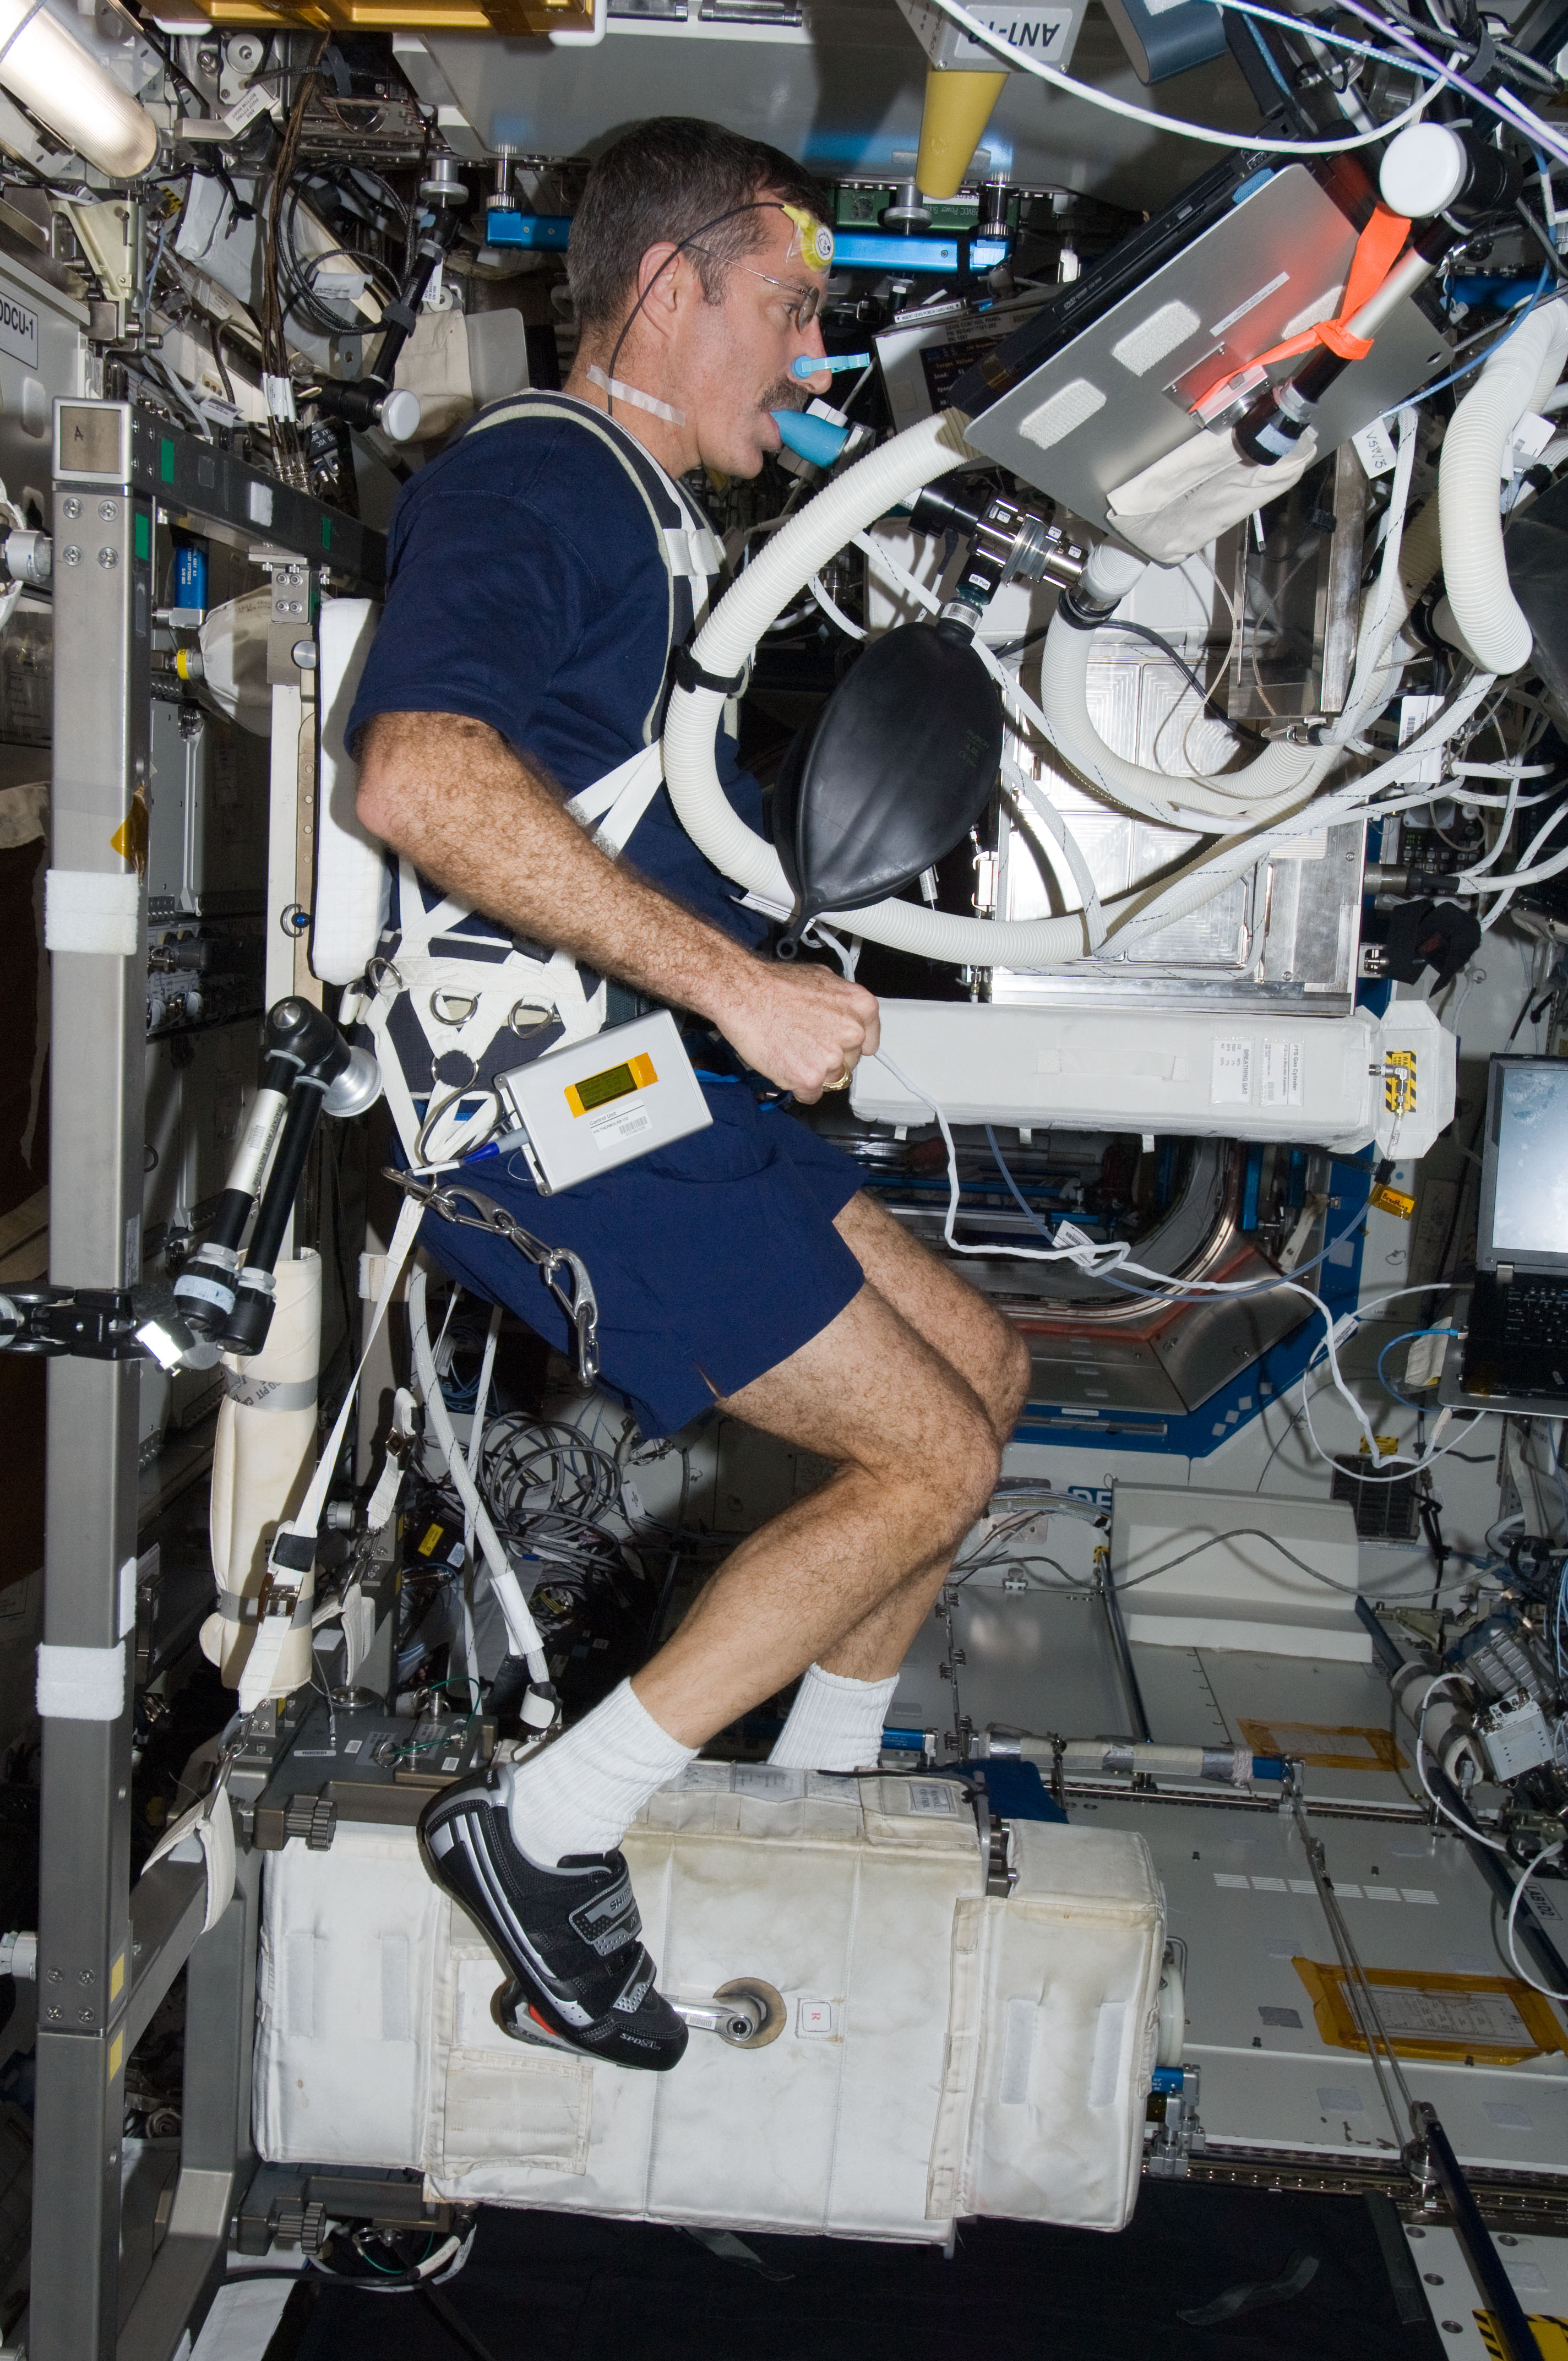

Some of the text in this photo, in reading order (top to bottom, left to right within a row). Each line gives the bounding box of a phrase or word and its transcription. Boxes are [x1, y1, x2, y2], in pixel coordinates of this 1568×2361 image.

[231, 92, 257, 118] BOTTOM RIGHT
[235, 97, 259, 121] PIVOT FITTING
[246, 108, 255, 118] ARIS
[941, 206, 957, 215] Power
[74, 425, 83, 440] A
[314, 438, 326, 447] VDC
[999, 510, 1010, 519] PART
[1050, 526, 1061, 535] PART
[1069, 546, 1081, 554] PART
[979, 579, 989, 587] Port
[269, 1102, 284, 1133] BRACKET
[589, 1115, 606, 1126] Control
[251, 1152, 267, 1187] MULTI-USE
[255, 1385, 270, 1399] PIT
[919, 1789, 930, 1808] CONTROL
[930, 1789, 940, 1808] MANUAL
[1524, 1886, 1555, 1917] LAB1D2
